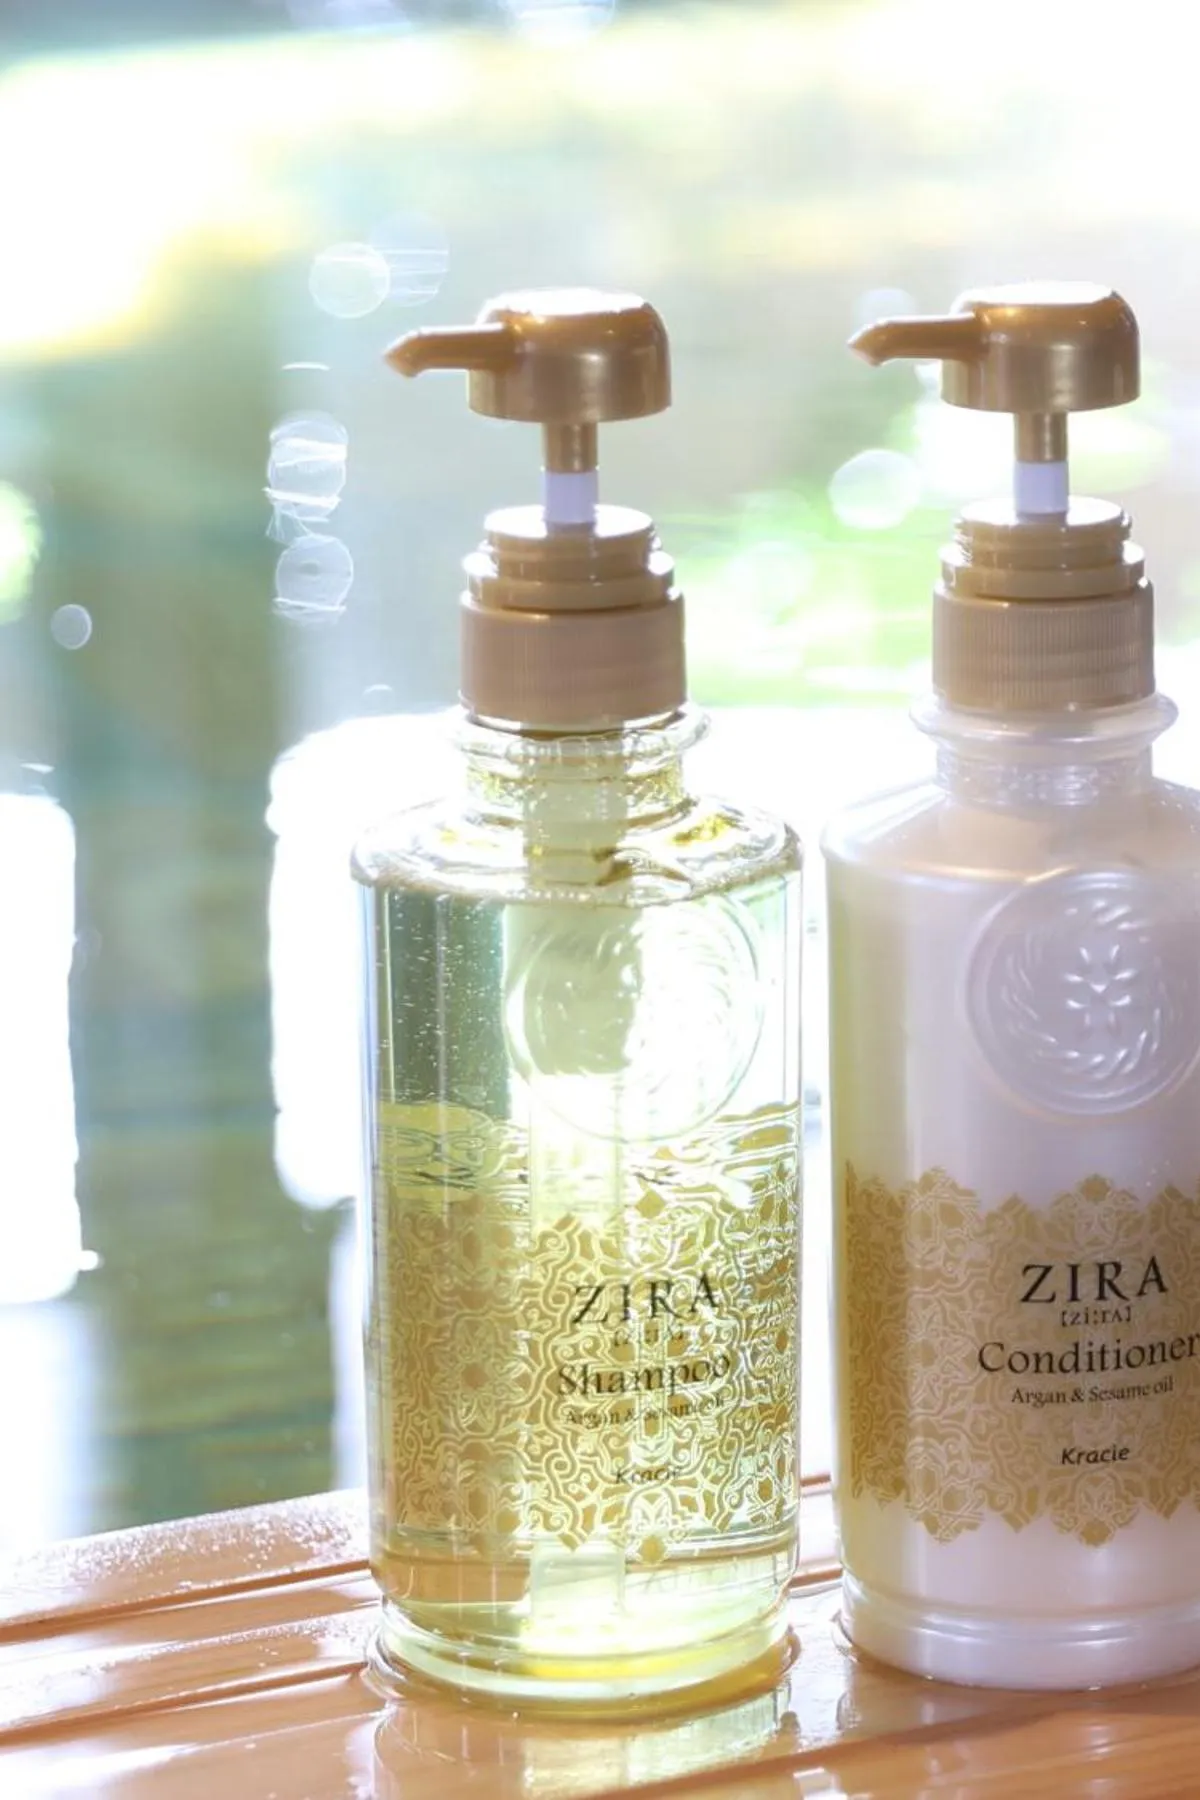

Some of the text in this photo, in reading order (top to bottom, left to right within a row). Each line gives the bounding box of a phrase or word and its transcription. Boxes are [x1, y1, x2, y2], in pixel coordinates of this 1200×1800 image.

[572, 1272, 719, 1325] ZIRA
[1020, 1255, 1169, 1304] ZIRA
[977, 1333, 1200, 1375] Conditioner
[557, 1354, 731, 1397] Shampoo
[1011, 1374, 1175, 1409] Argan & Sesame oil
[1060, 1444, 1131, 1466] Kracie
